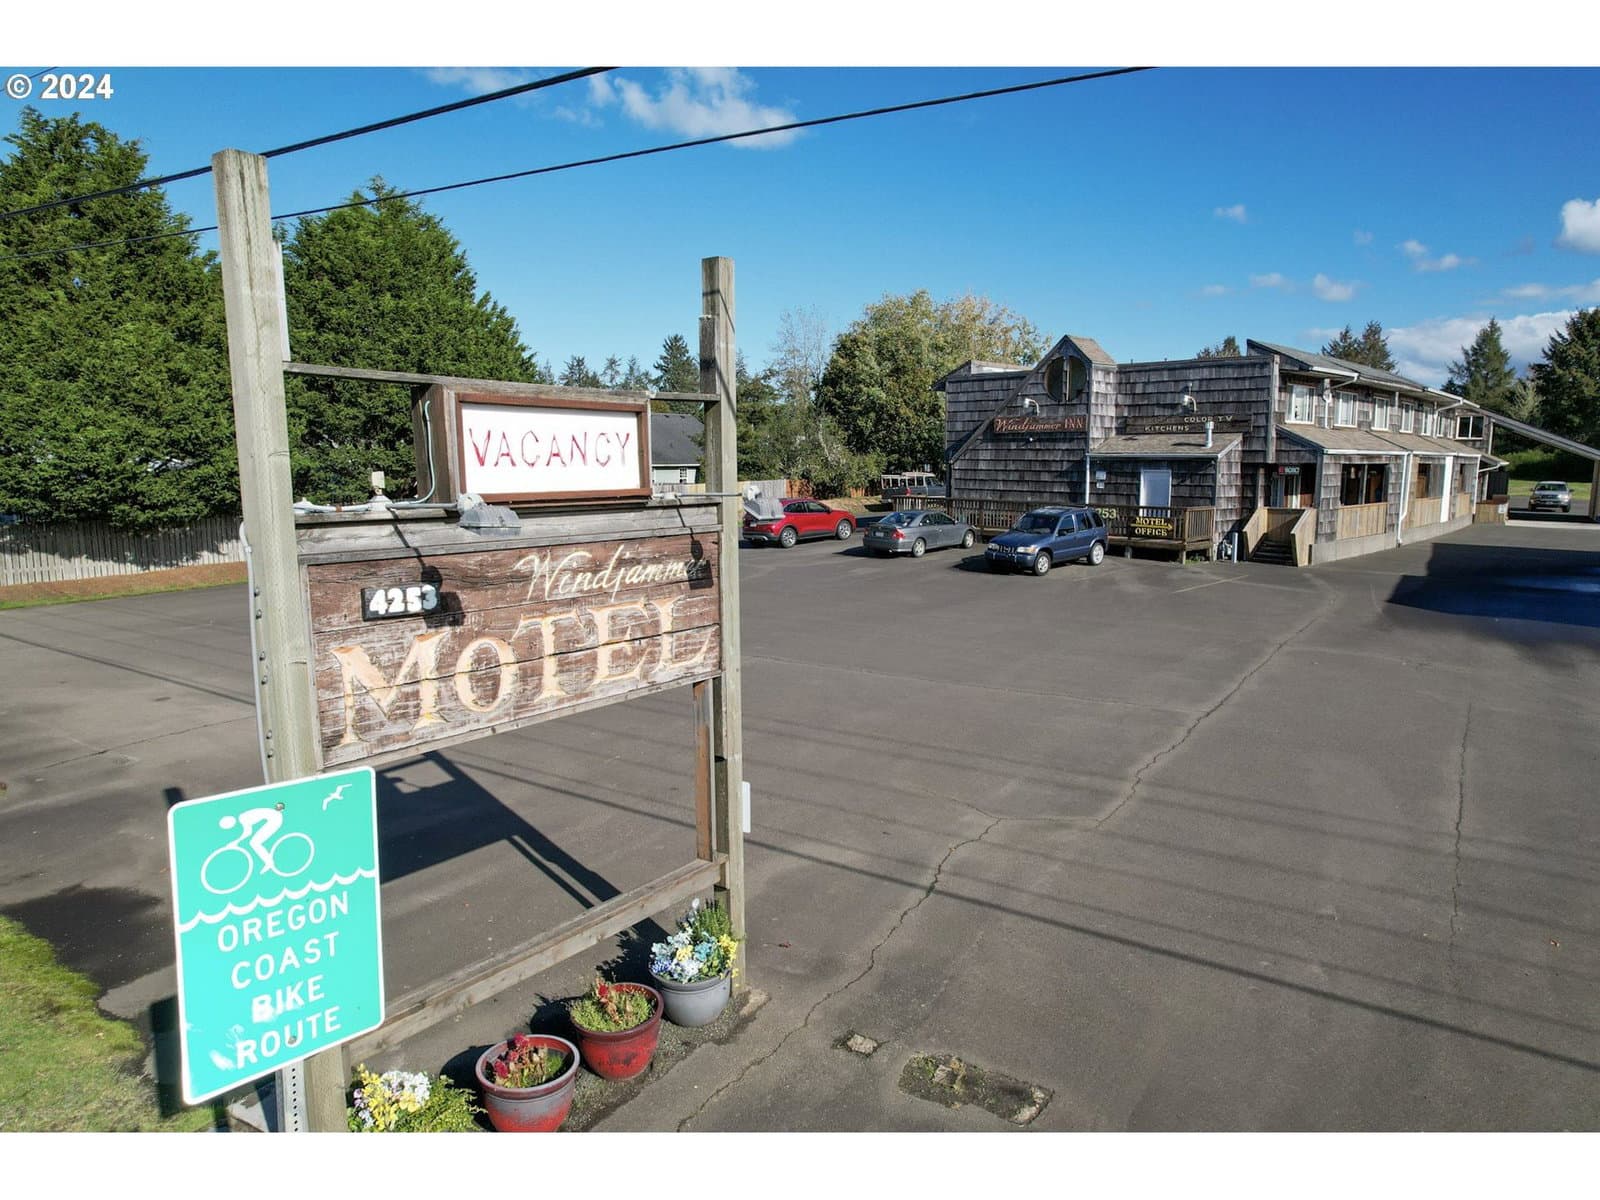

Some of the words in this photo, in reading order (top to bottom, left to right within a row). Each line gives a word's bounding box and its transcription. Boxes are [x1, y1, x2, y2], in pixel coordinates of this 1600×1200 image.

[994, 416, 1061, 432] Windjammer
[1064, 416, 1084, 430] INN
[1144, 424, 1190, 432] KITCHENS
[468, 428, 631, 468] VACANCY
[1135, 516, 1168, 526] MOTEL
[1135, 527, 1168, 537] OFFICE
[513, 544, 707, 602] Windjammer
[369, 584, 438, 615] 4253
[330, 596, 719, 748] MOTEL
[217, 890, 349, 953] OREGON
[230, 931, 340, 990] COAST
[251, 974, 325, 1024] BIKE
[235, 1005, 342, 1070] ROUTE
